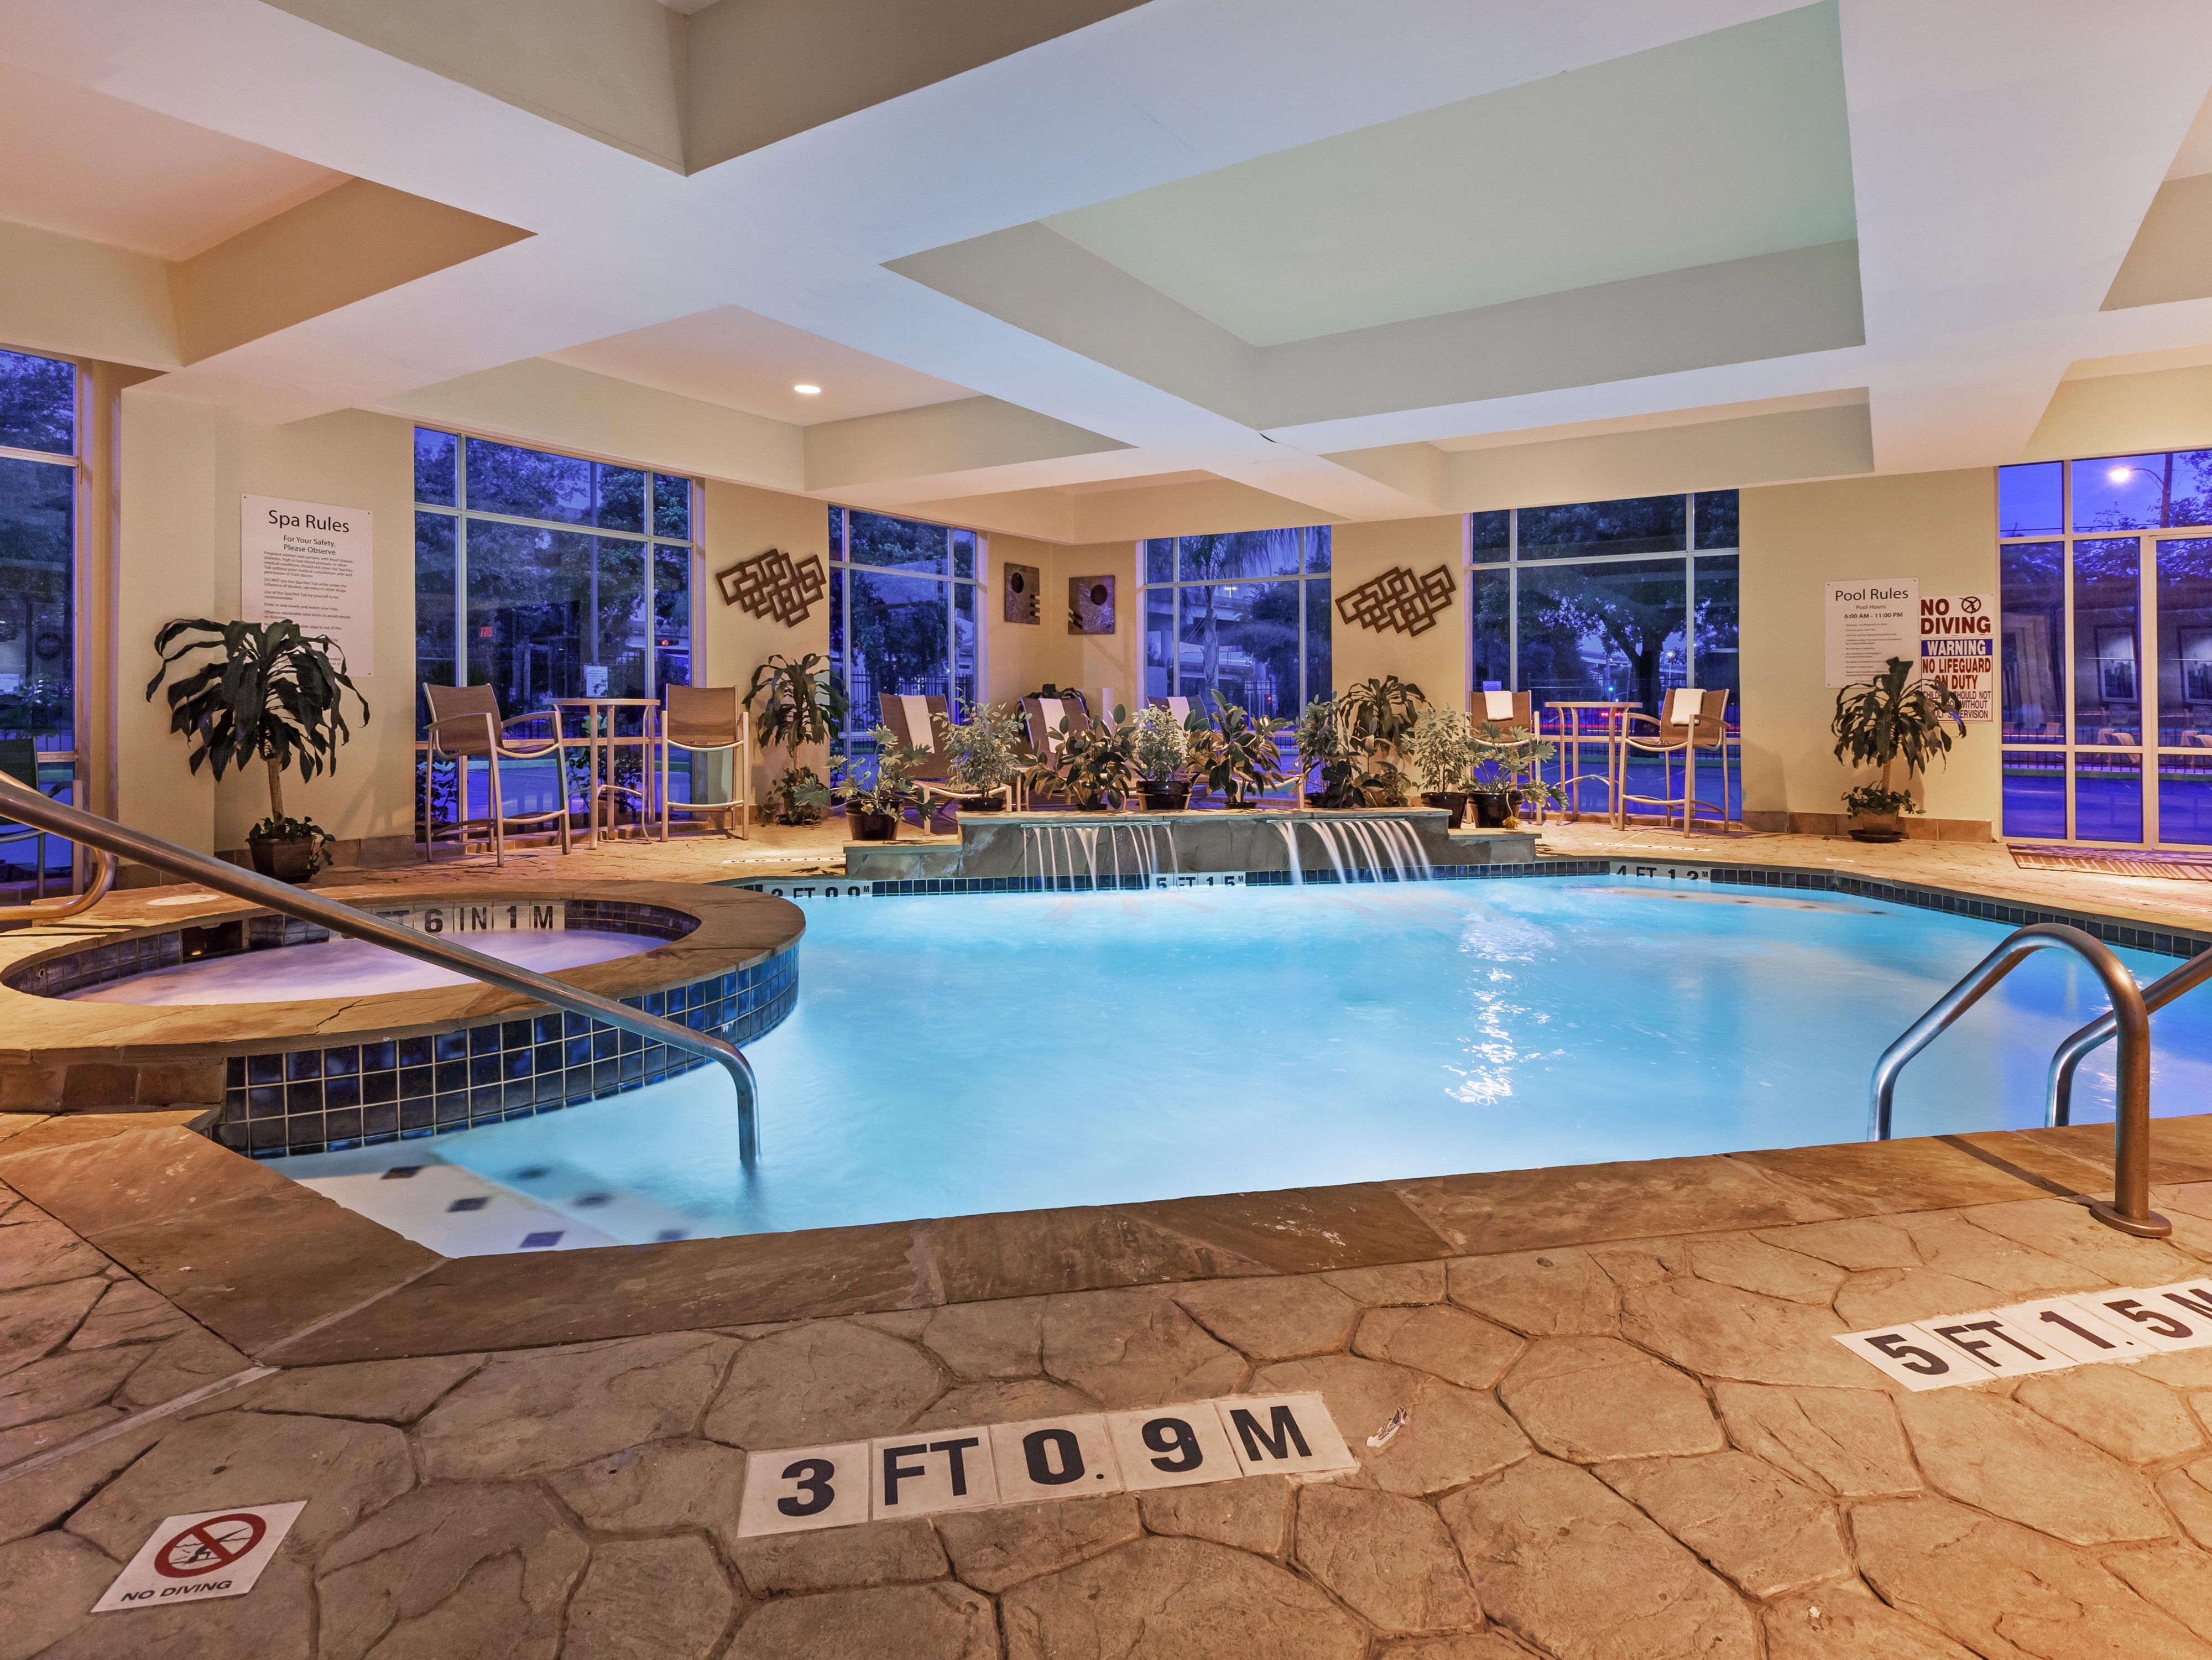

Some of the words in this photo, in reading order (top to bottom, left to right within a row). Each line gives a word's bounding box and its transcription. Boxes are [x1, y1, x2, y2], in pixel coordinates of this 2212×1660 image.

[269, 510, 300, 529] Spa
[306, 514, 349, 533] Rules
[314, 538, 336, 547] Safety,
[307, 547, 336, 555] Observe
[1835, 589, 1865, 601] Pool
[1871, 587, 1908, 600] Rules
[1921, 599, 1949, 616] NO
[1921, 616, 1991, 634] DIVING
[1927, 640, 1986, 655] WARNING
[1923, 658, 1935, 674] NO
[1939, 658, 1991, 673] LIFEGUARD
[1952, 674, 1978, 690] DUTY
[1979, 691, 1991, 700] NOT
[1636, 866, 1657, 878] FT
[1207, 876, 1214, 887] 1
[794, 887, 816, 899] FT
[425, 909, 443, 933] 6
[460, 907, 487, 931] IN
[507, 906, 517, 928] 1
[534, 906, 553, 929] M
[1864, 1334, 1949, 1375] 5
[1933, 1320, 2047, 1367] FT
[778, 1459, 835, 1517] 3
[884, 1437, 979, 1506] FT
[1229, 1406, 1312, 1463] M
[121, 1590, 155, 1602] NO
[160, 1580, 232, 1597] DIVING
